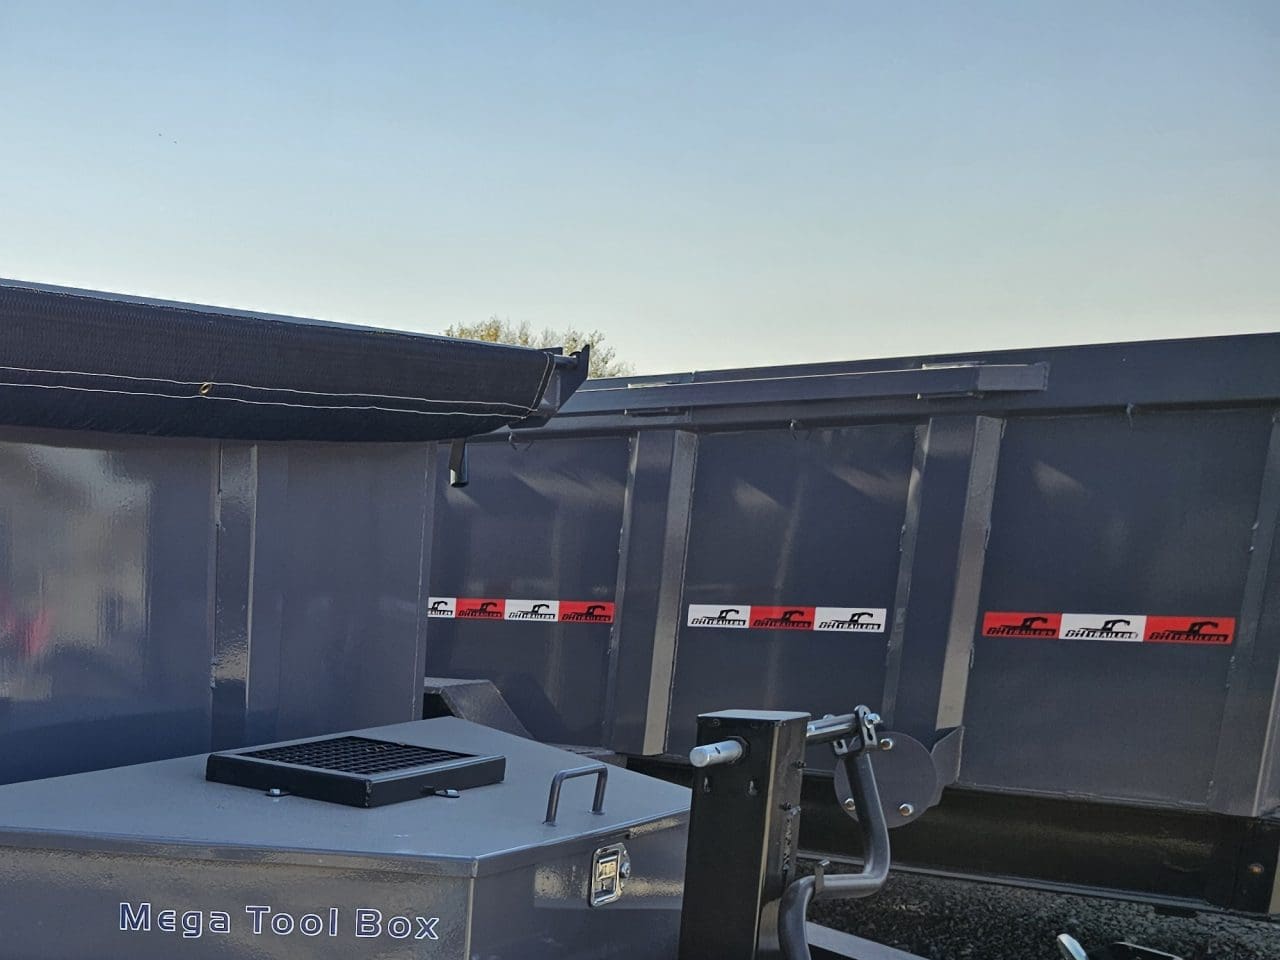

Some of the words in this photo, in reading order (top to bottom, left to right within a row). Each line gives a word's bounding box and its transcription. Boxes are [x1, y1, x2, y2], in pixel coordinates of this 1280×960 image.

[120, 902, 231, 938] Mega
[246, 905, 338, 936] Tool
[355, 908, 439, 940] Box
